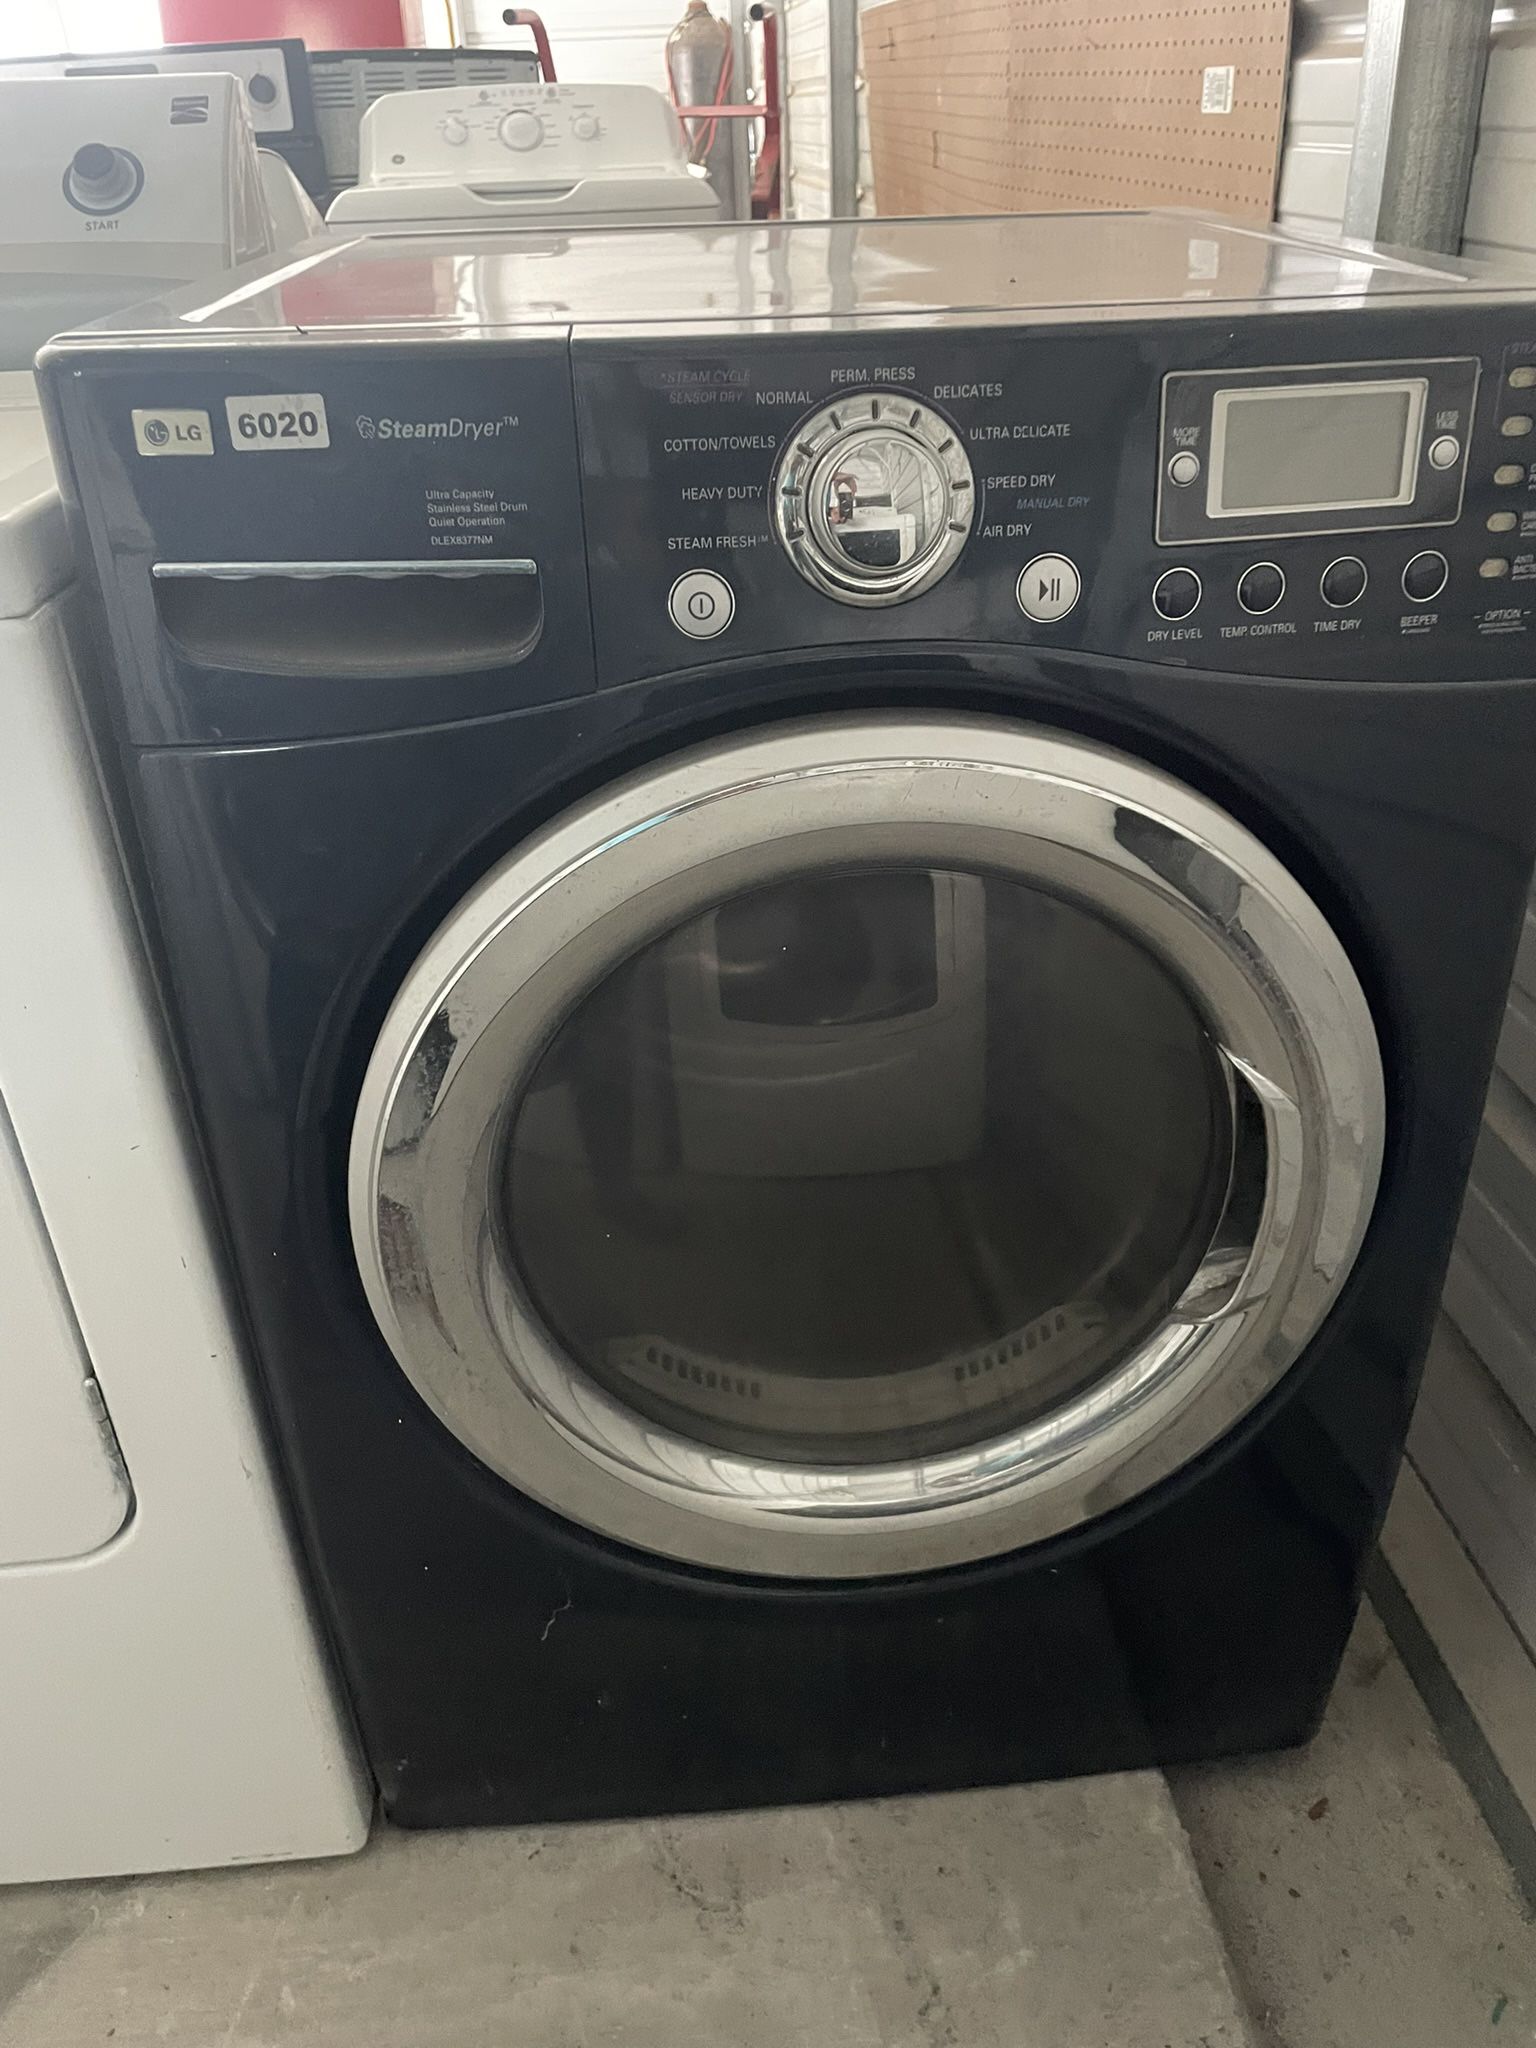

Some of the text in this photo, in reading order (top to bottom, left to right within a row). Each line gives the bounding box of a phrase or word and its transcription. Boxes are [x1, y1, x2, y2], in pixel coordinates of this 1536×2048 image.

[85, 221, 119, 231] START
[830, 367, 915, 382] PERM. PRESS
[756, 391, 813, 405] NORMAL
[934, 384, 1003, 399] DELICATES
[238, 411, 318, 439] 6020
[175, 425, 202, 441] LG
[969, 424, 1071, 441] ULTRA DELICATE
[664, 435, 776, 452] COTTON/TOWELS
[987, 474, 1056, 489] SPEED DRY
[425, 489, 495, 500] Ultra Capacity
[681, 486, 762, 501] HEAVY DUTY
[427, 501, 528, 513] Stainless Steel Drum
[1016, 496, 1090, 509] MANUAL DRY
[428, 516, 506, 527] Quiet Operation
[982, 523, 1033, 538] AIR DRY
[668, 537, 713, 550] STEAM
[1250, 622, 1297, 635] CONTROL
[1313, 619, 1362, 632] TIME DRY
[1147, 628, 1203, 642] DRY LEVEL
